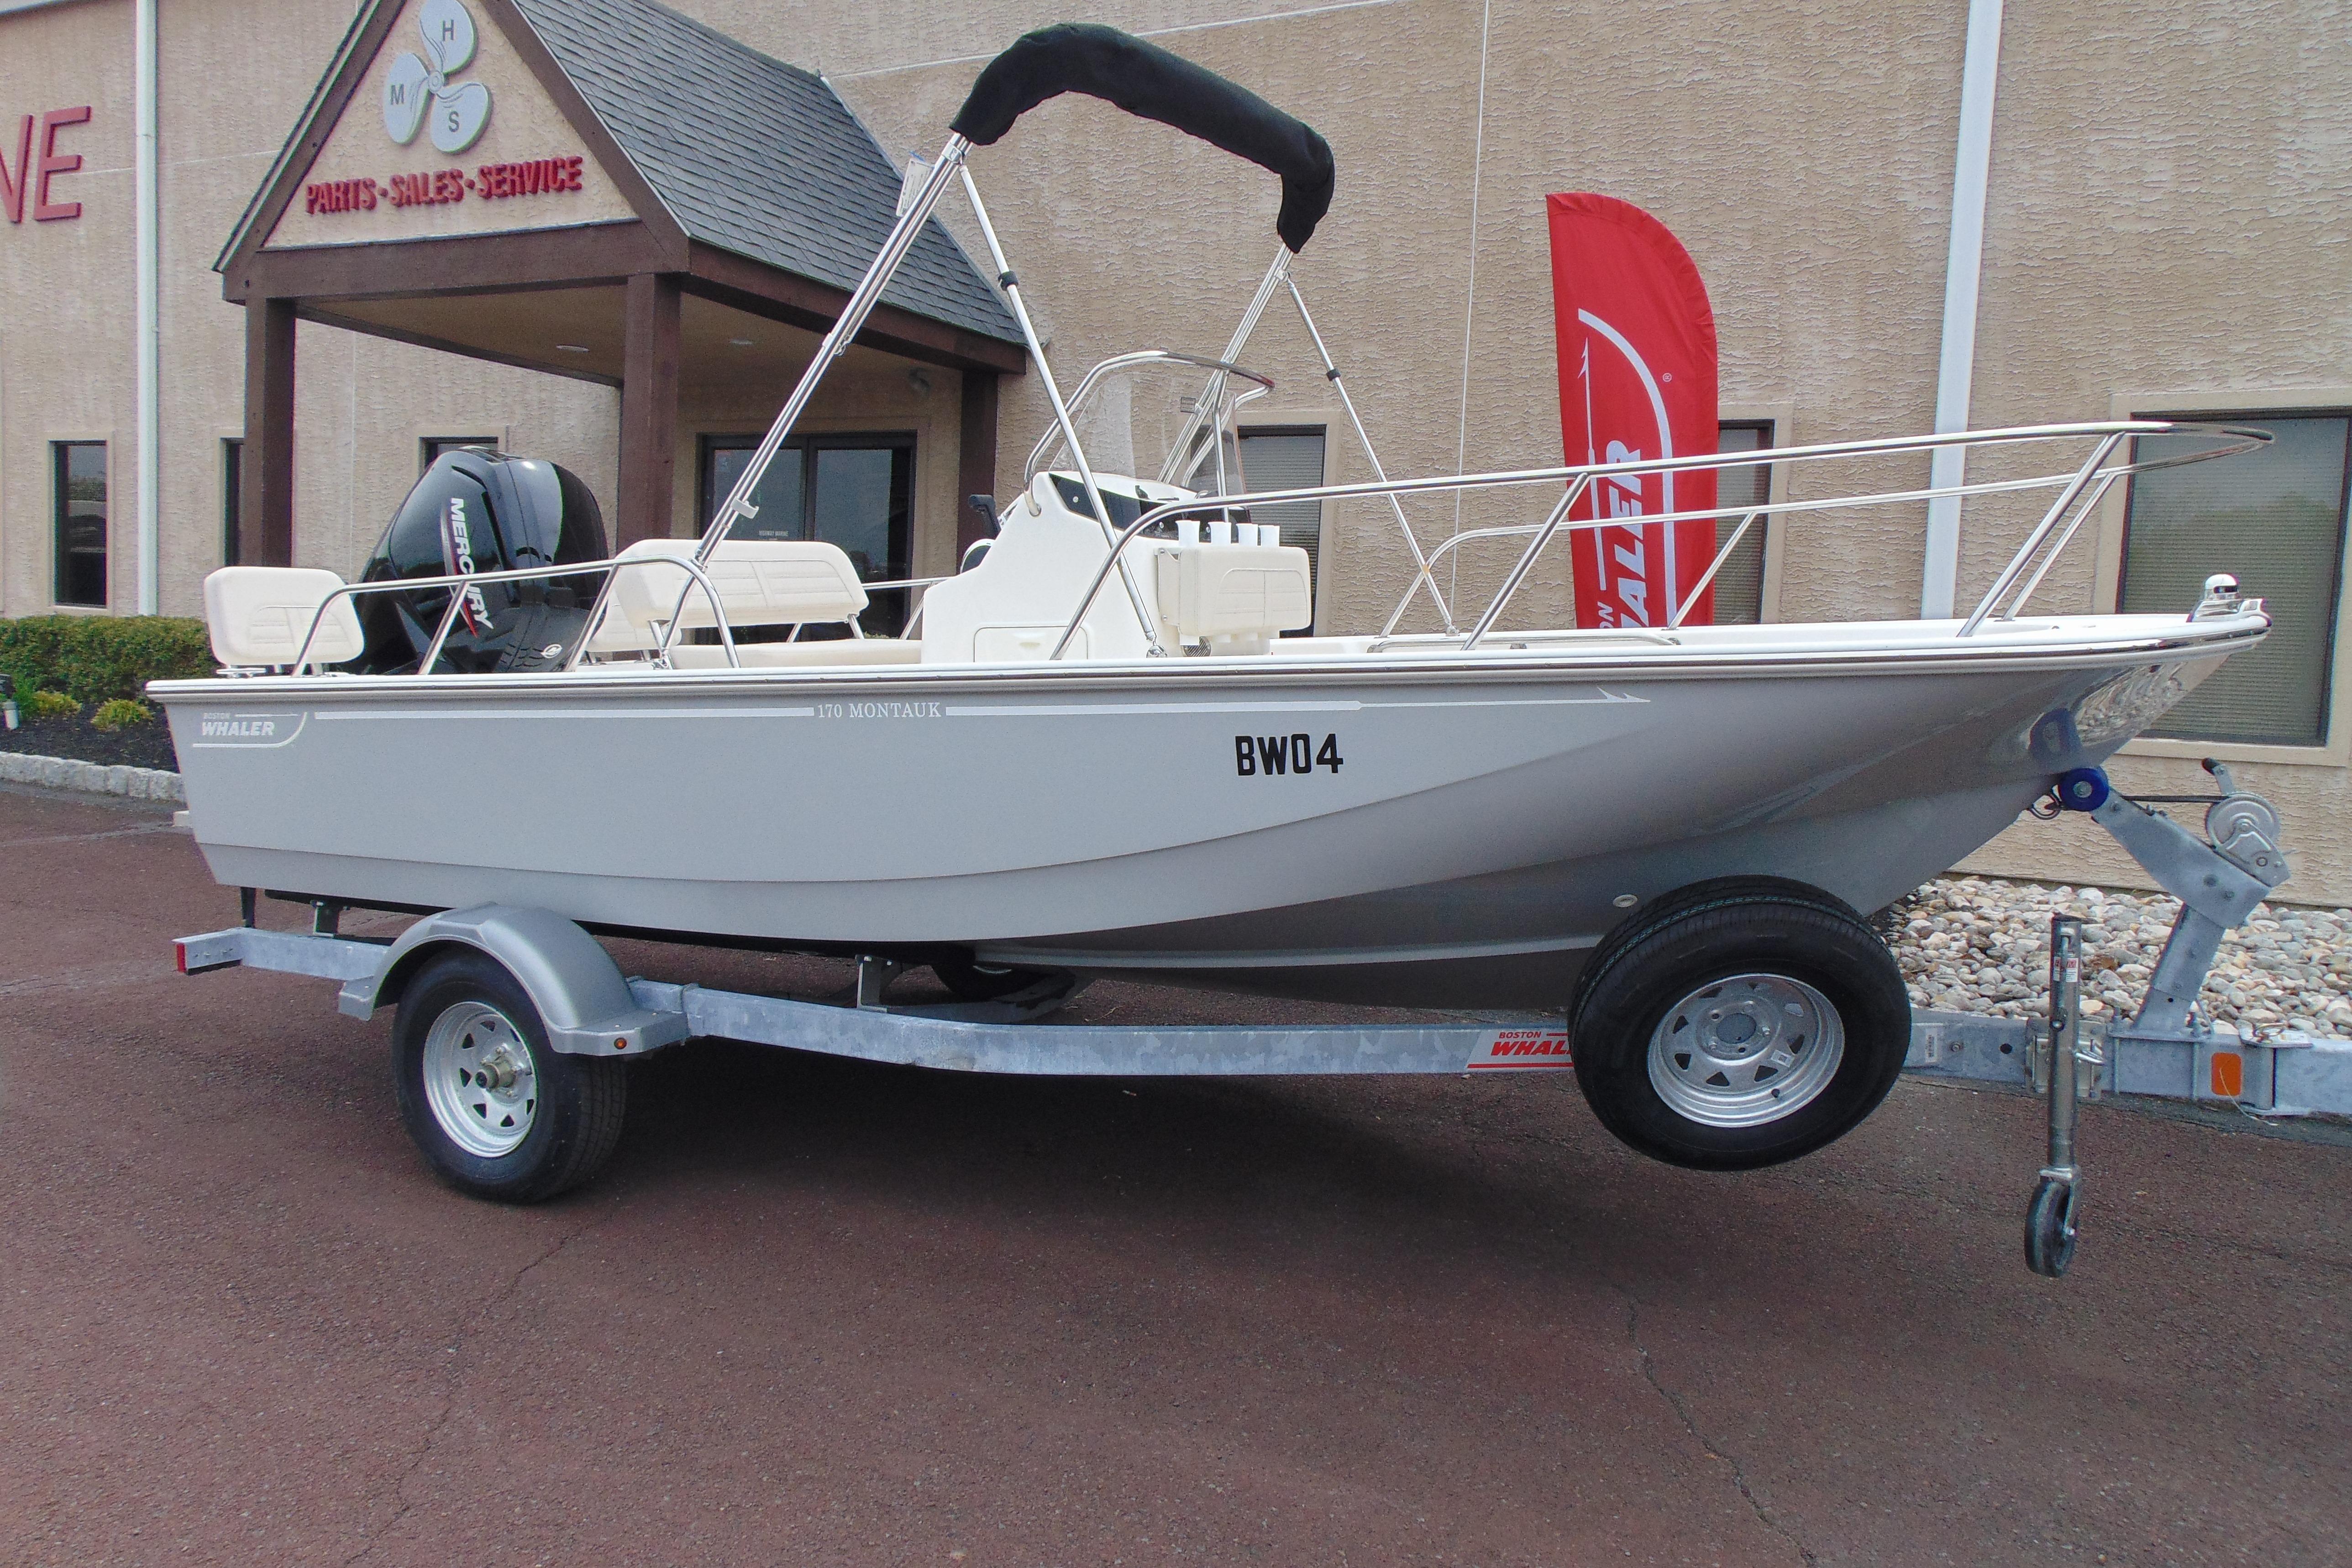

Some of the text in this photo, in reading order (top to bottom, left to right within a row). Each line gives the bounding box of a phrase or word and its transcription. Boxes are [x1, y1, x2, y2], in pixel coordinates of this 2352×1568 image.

[442, 19, 454, 41] H
[390, 84, 404, 105] M
[448, 111, 460, 133] S
[306, 156, 583, 215] PARTS SALES SERVICE
[817, 702, 942, 718] 170 MONTAUK
[202, 721, 275, 736] WHALER
[1491, 1040, 1571, 1056] WHAL
